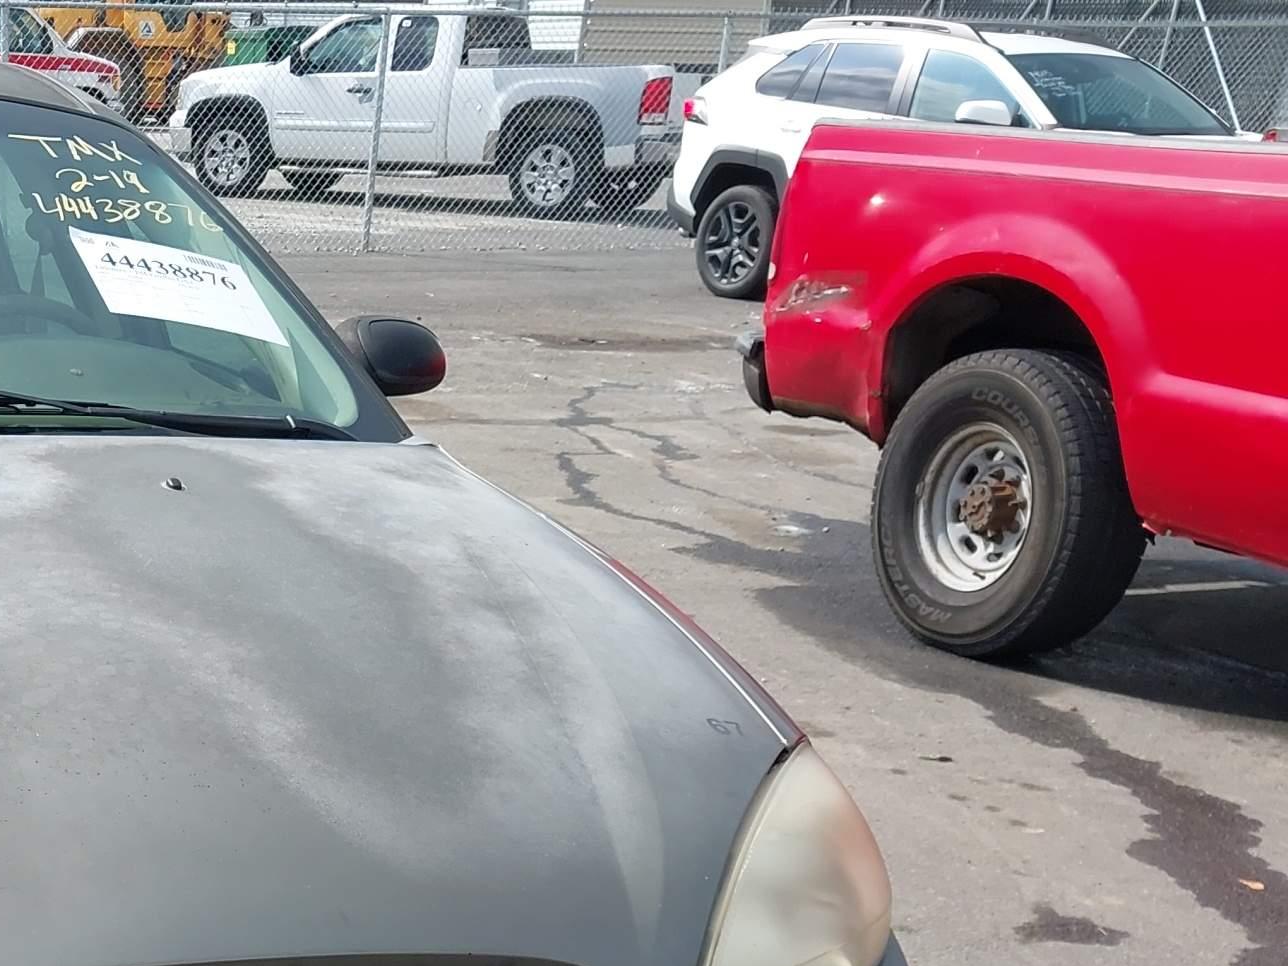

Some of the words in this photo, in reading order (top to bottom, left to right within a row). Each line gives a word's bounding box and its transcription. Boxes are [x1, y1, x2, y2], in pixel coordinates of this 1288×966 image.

[56, 168, 150, 194] 2-19
[32, 192, 224, 232] 44438876
[101, 252, 237, 291] 44438876
[706, 718, 744, 736] 67
